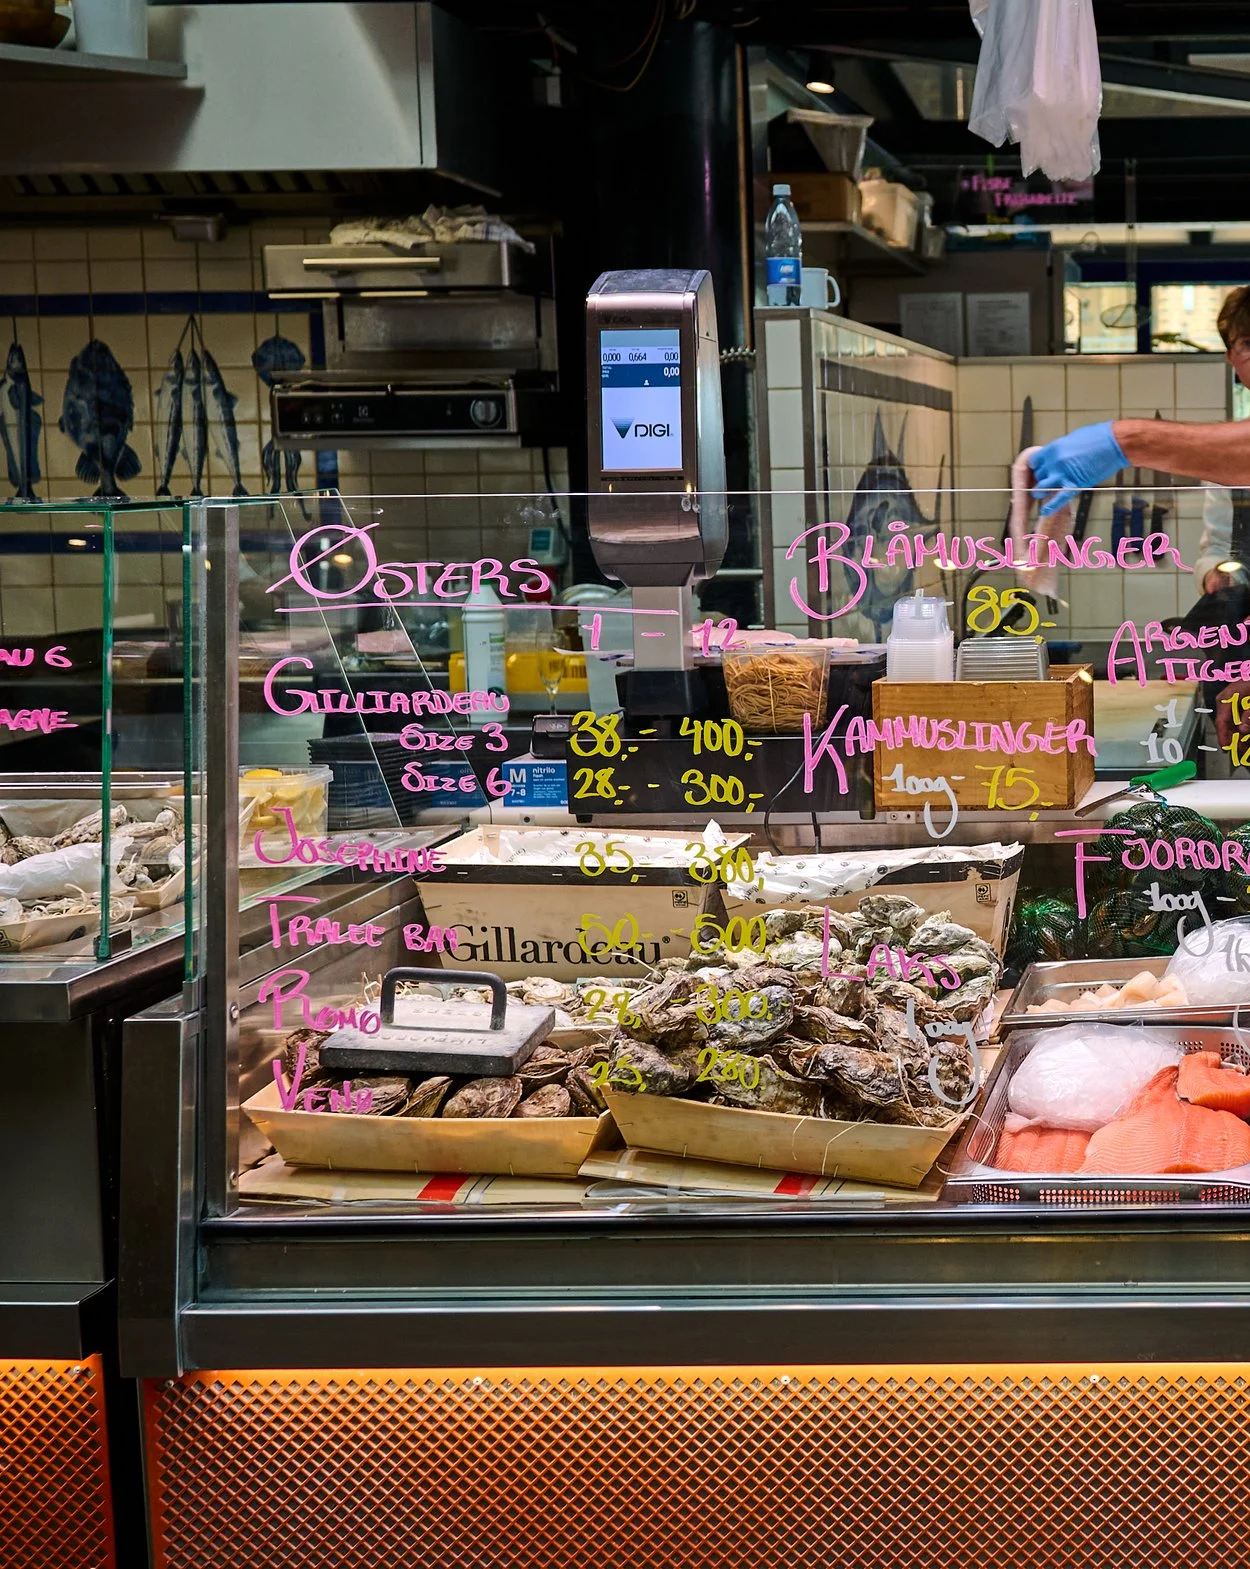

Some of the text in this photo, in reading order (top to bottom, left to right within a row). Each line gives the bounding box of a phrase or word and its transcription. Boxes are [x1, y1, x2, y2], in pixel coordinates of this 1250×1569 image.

[634, 423, 670, 437] DIGI
[265, 522, 551, 599] ØSTERS
[785, 519, 1195, 621] BLÅMUSLINGER
[44, 645, 73, 668] 6
[688, 617, 745, 657] 12
[263, 656, 511, 717] GILLIARDEAU
[400, 722, 476, 751] SIZE
[481, 722, 509, 752] 3
[803, 704, 1099, 796] KAMMUSLINGER
[400, 761, 477, 793] SIZE
[486, 767, 513, 797] 6
[509, 768, 526, 783] M
[254, 806, 448, 874] JOSEPHINE
[253, 895, 386, 949] TRALEE
[403, 922, 459, 952] BAY
[821, 905, 963, 990] LAKS
